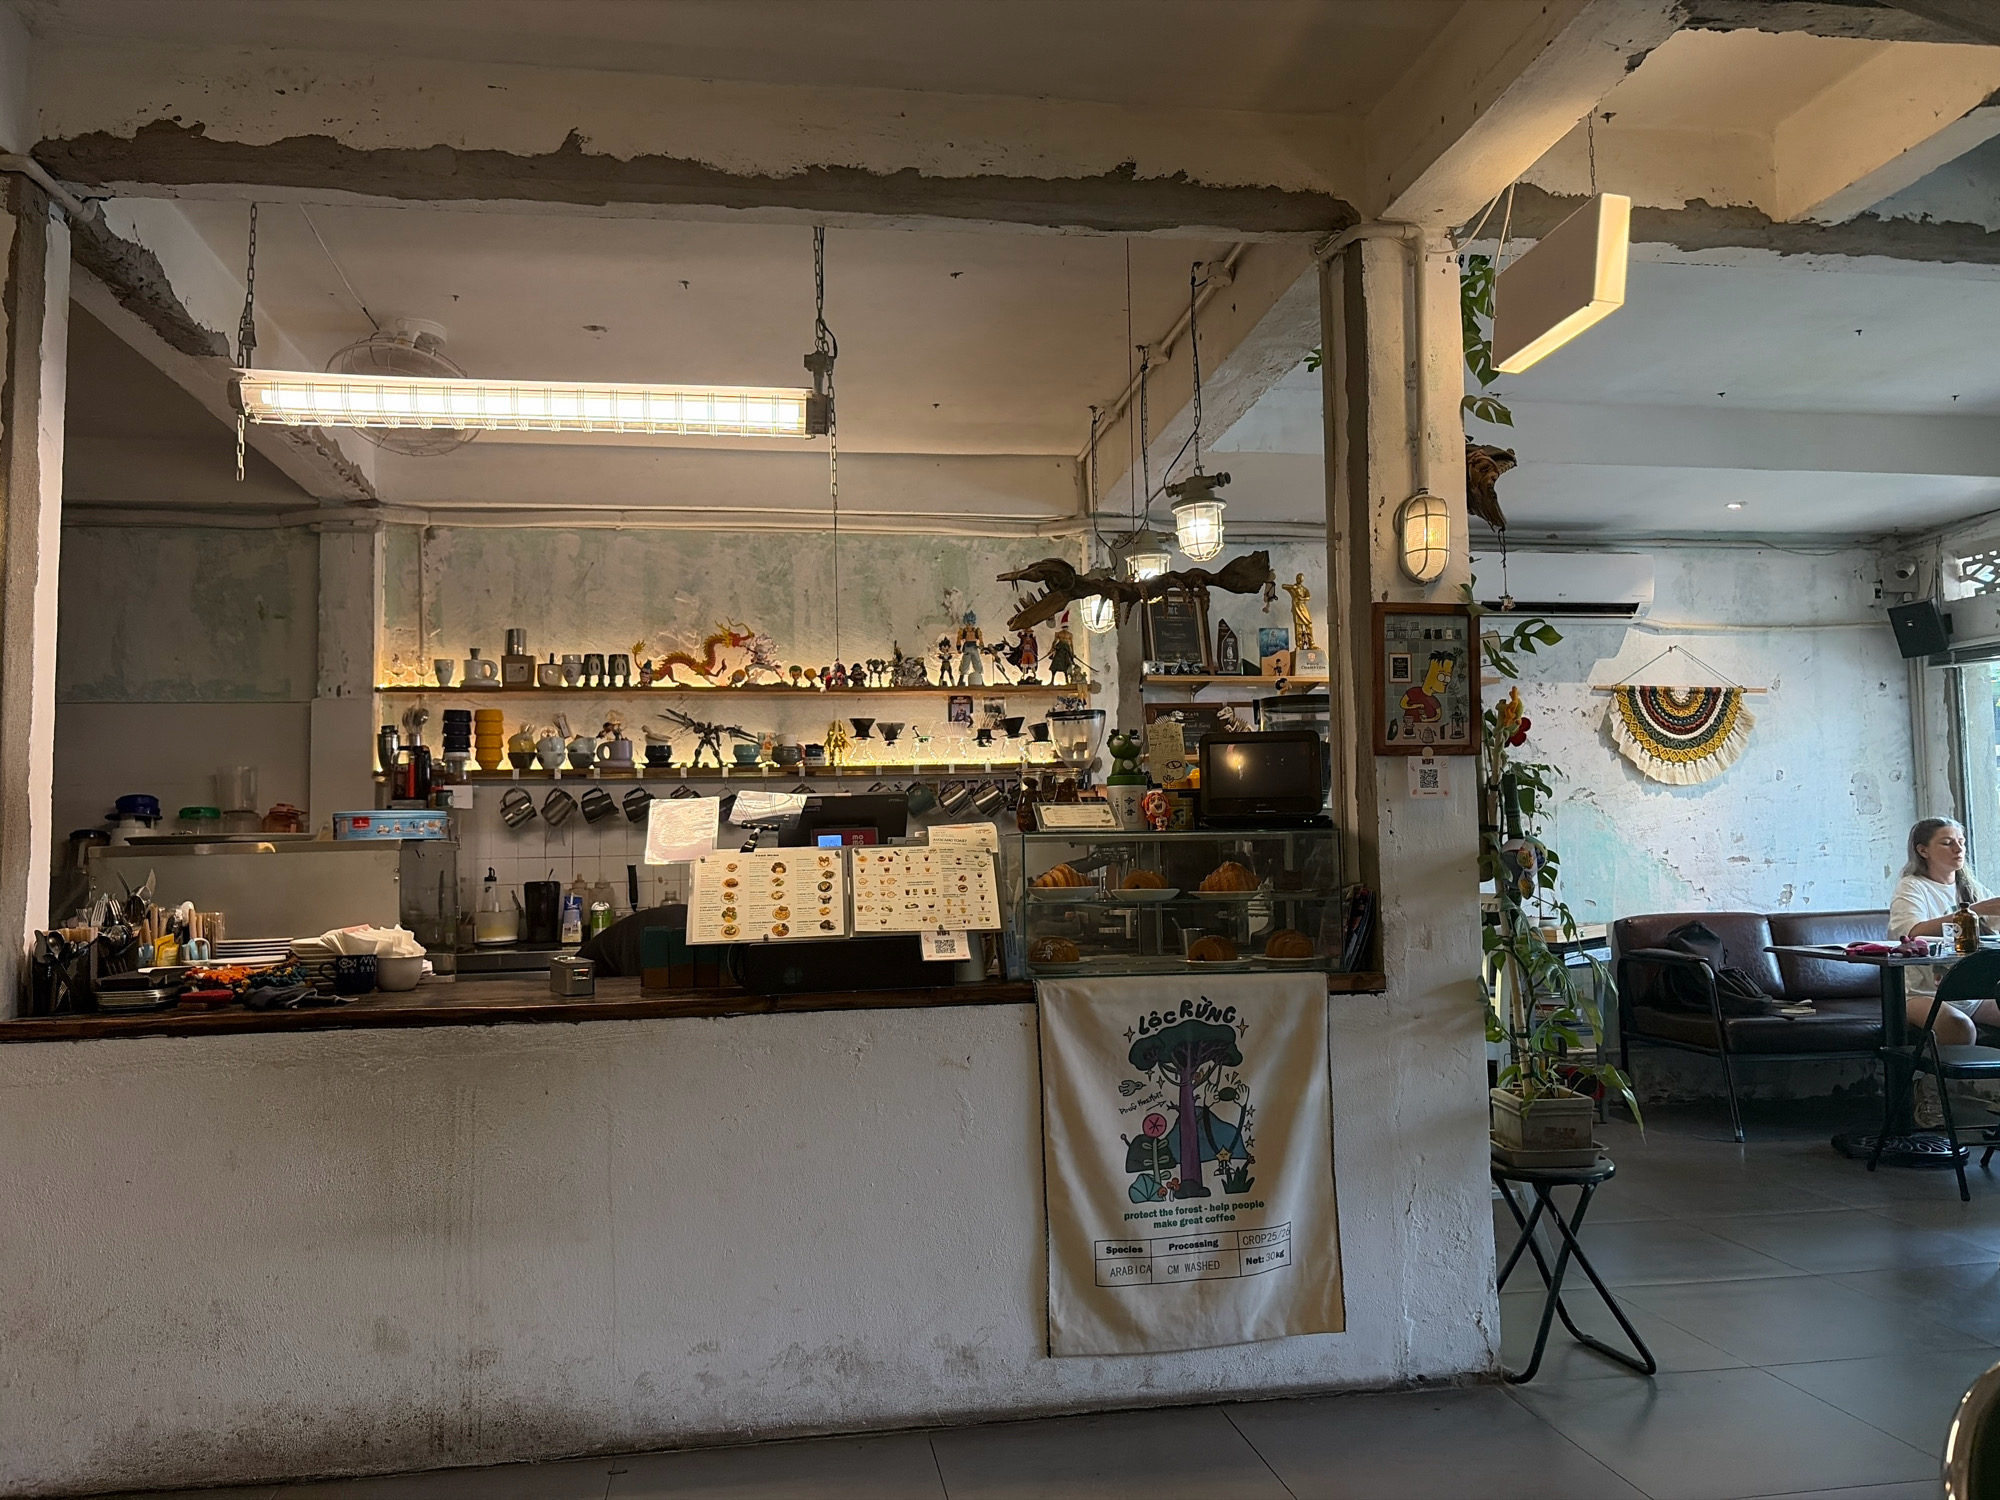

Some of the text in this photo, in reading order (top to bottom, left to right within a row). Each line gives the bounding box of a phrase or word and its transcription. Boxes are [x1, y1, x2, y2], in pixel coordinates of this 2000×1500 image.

[1124, 1210, 1158, 1221] protect
[1159, 1208, 1174, 1217] the
[1175, 1204, 1203, 1216] forest
[1209, 1202, 1230, 1213] help
[1232, 1200, 1265, 1212] people
[1153, 1213, 1236, 1229] make great coffee
[1105, 1245, 1143, 1255] Species
[1168, 1238, 1219, 1251] Processing
[1167, 1260, 1221, 1275] CM WASHED
[1245, 1256, 1265, 1266] Net:
[1109, 1264, 1152, 1278] ARABICA
